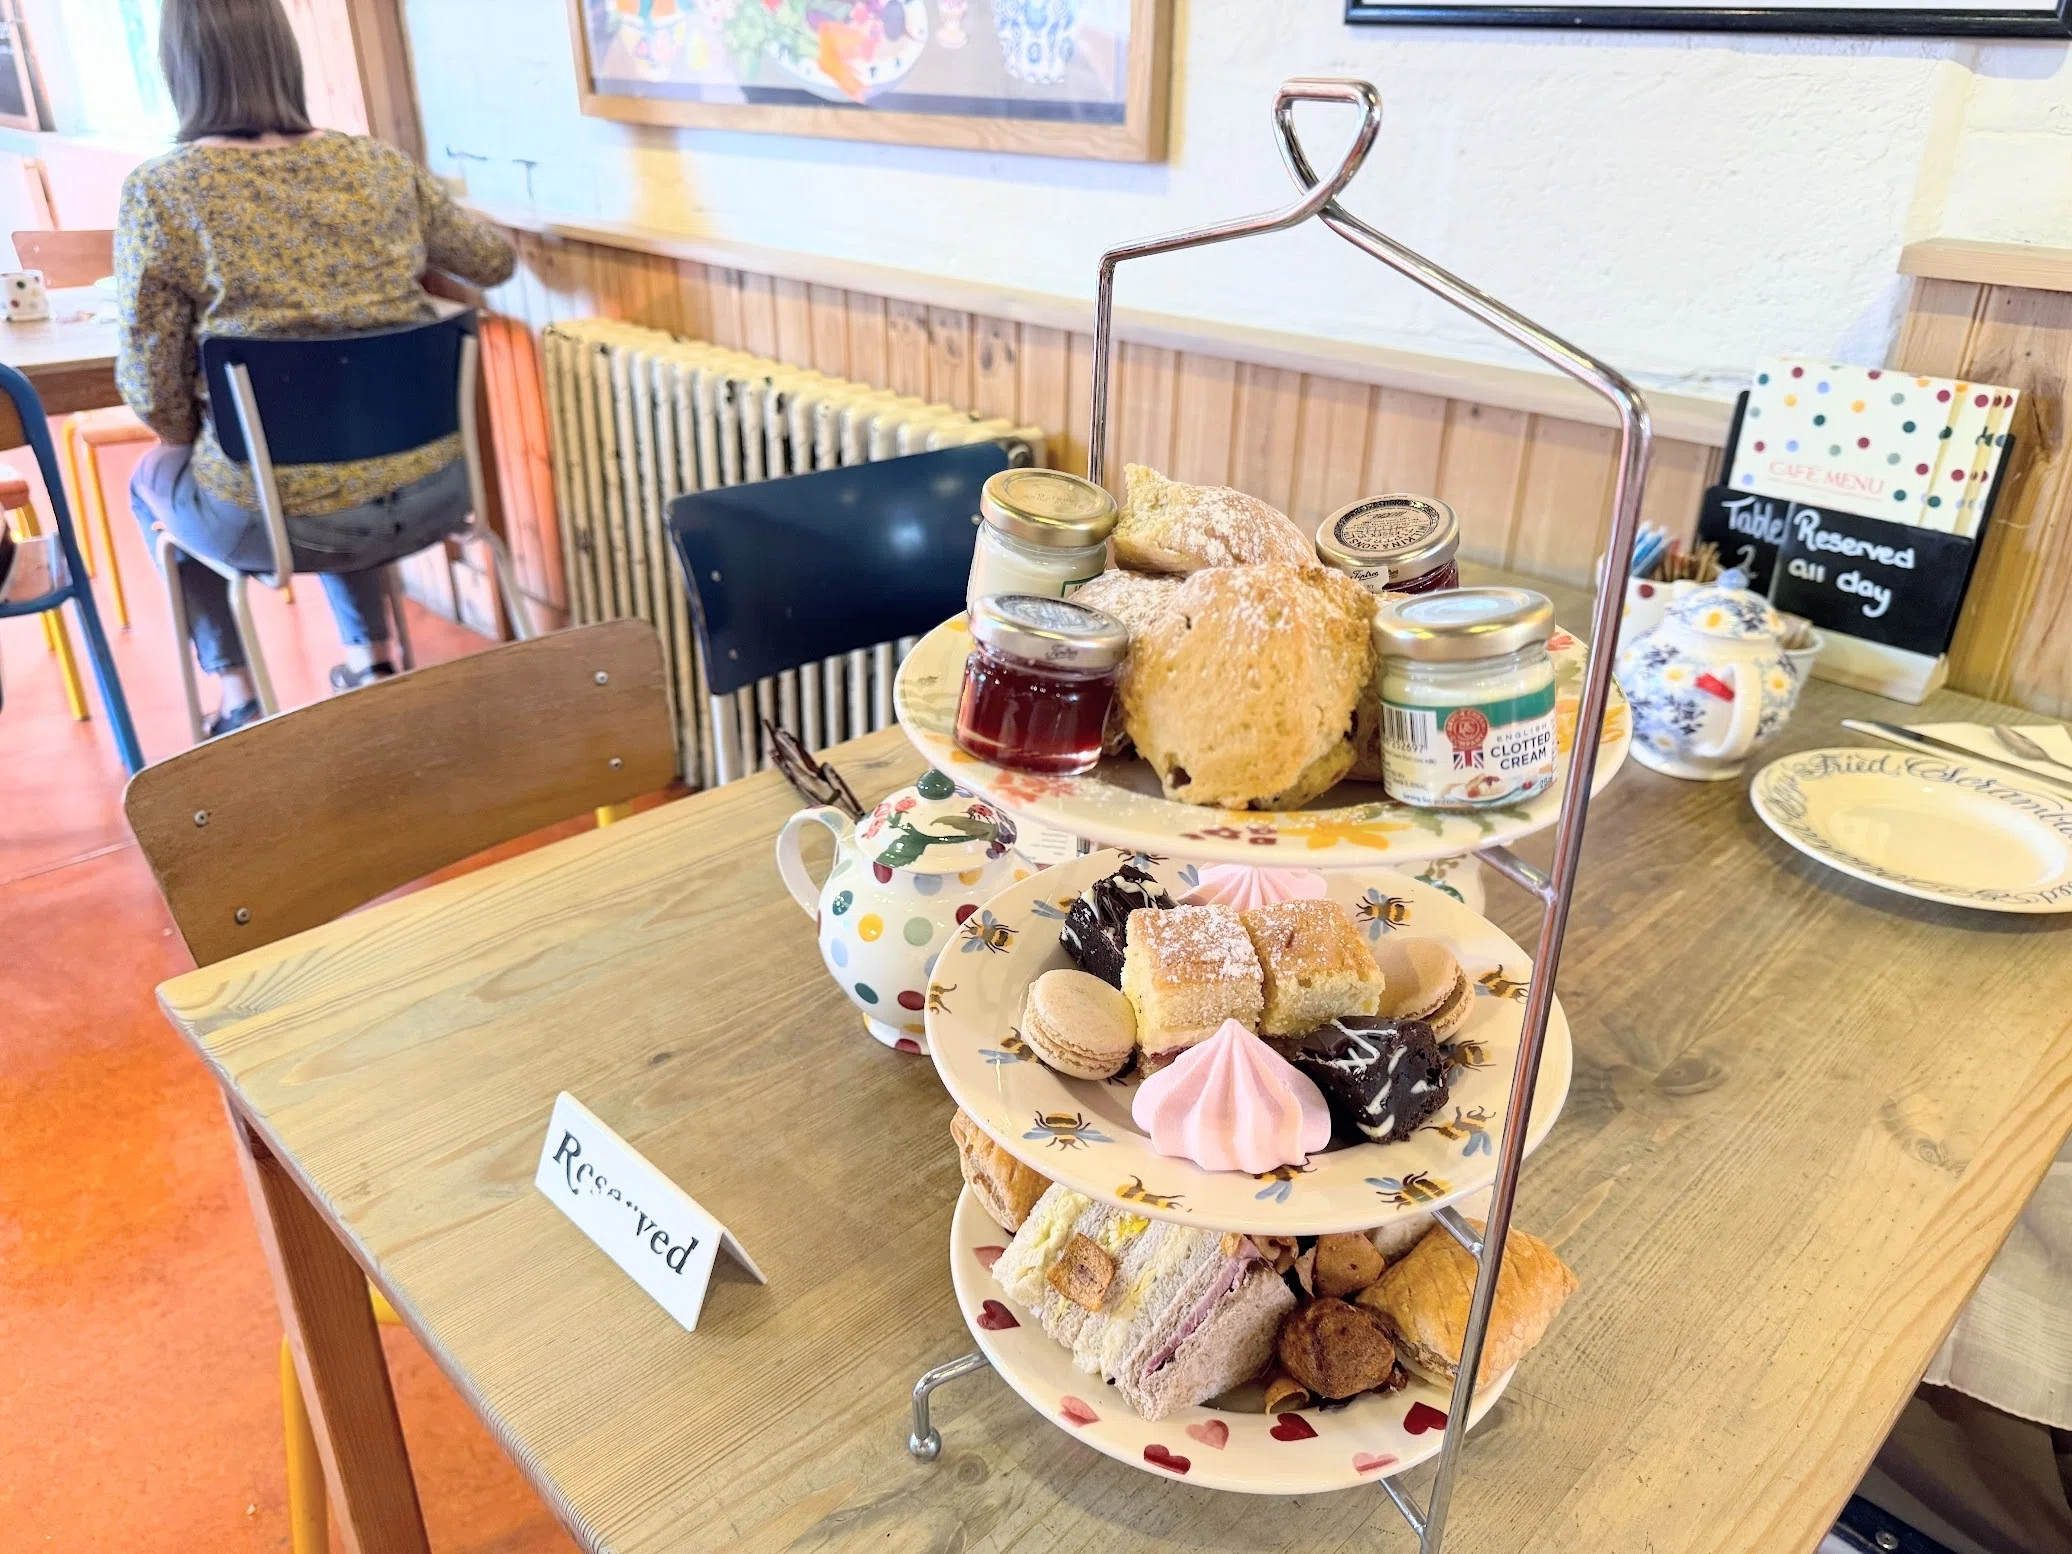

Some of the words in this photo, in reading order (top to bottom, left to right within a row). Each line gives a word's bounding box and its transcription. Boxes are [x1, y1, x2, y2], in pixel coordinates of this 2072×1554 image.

[1769, 459, 1819, 483] CAFE
[1824, 471, 1885, 495] MENU
[1721, 495, 1787, 545] Table
[1349, 538, 1379, 550] SONS
[1794, 510, 1916, 570] Reserved
[1788, 558, 1825, 583] all
[1836, 570, 1893, 618] day
[1490, 731, 1551, 758] CLOTTED
[1496, 723, 1548, 742] ENGLISH
[1500, 746, 1547, 771] CREAM
[552, 1128, 700, 1275] Reseved
